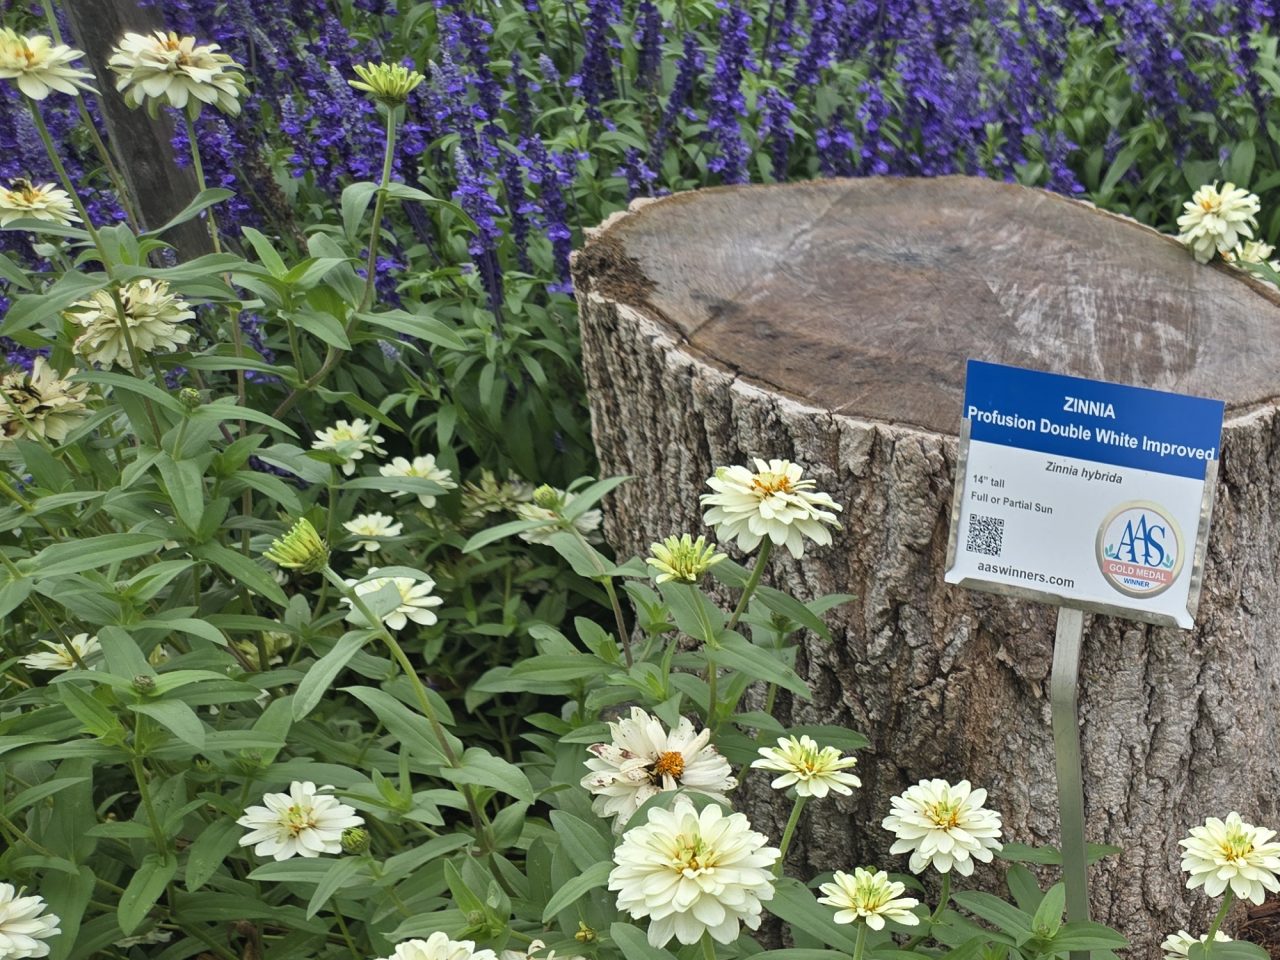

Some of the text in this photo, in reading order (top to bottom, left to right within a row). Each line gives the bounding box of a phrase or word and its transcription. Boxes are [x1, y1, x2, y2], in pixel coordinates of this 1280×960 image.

[1063, 396, 1116, 419] ZINNIA
[967, 405, 1215, 461] Profusion Double White Improved
[972, 474, 1005, 488] 14" tall
[1045, 461, 1123, 484] Zinnia hybrida
[971, 491, 1053, 515] Full or Partial Sun
[1113, 513, 1166, 568] AAS
[977, 562, 1075, 588] aaswinners.com
[1109, 563, 1167, 581] GOLD MEDAL
[1123, 577, 1150, 588] WINNER
